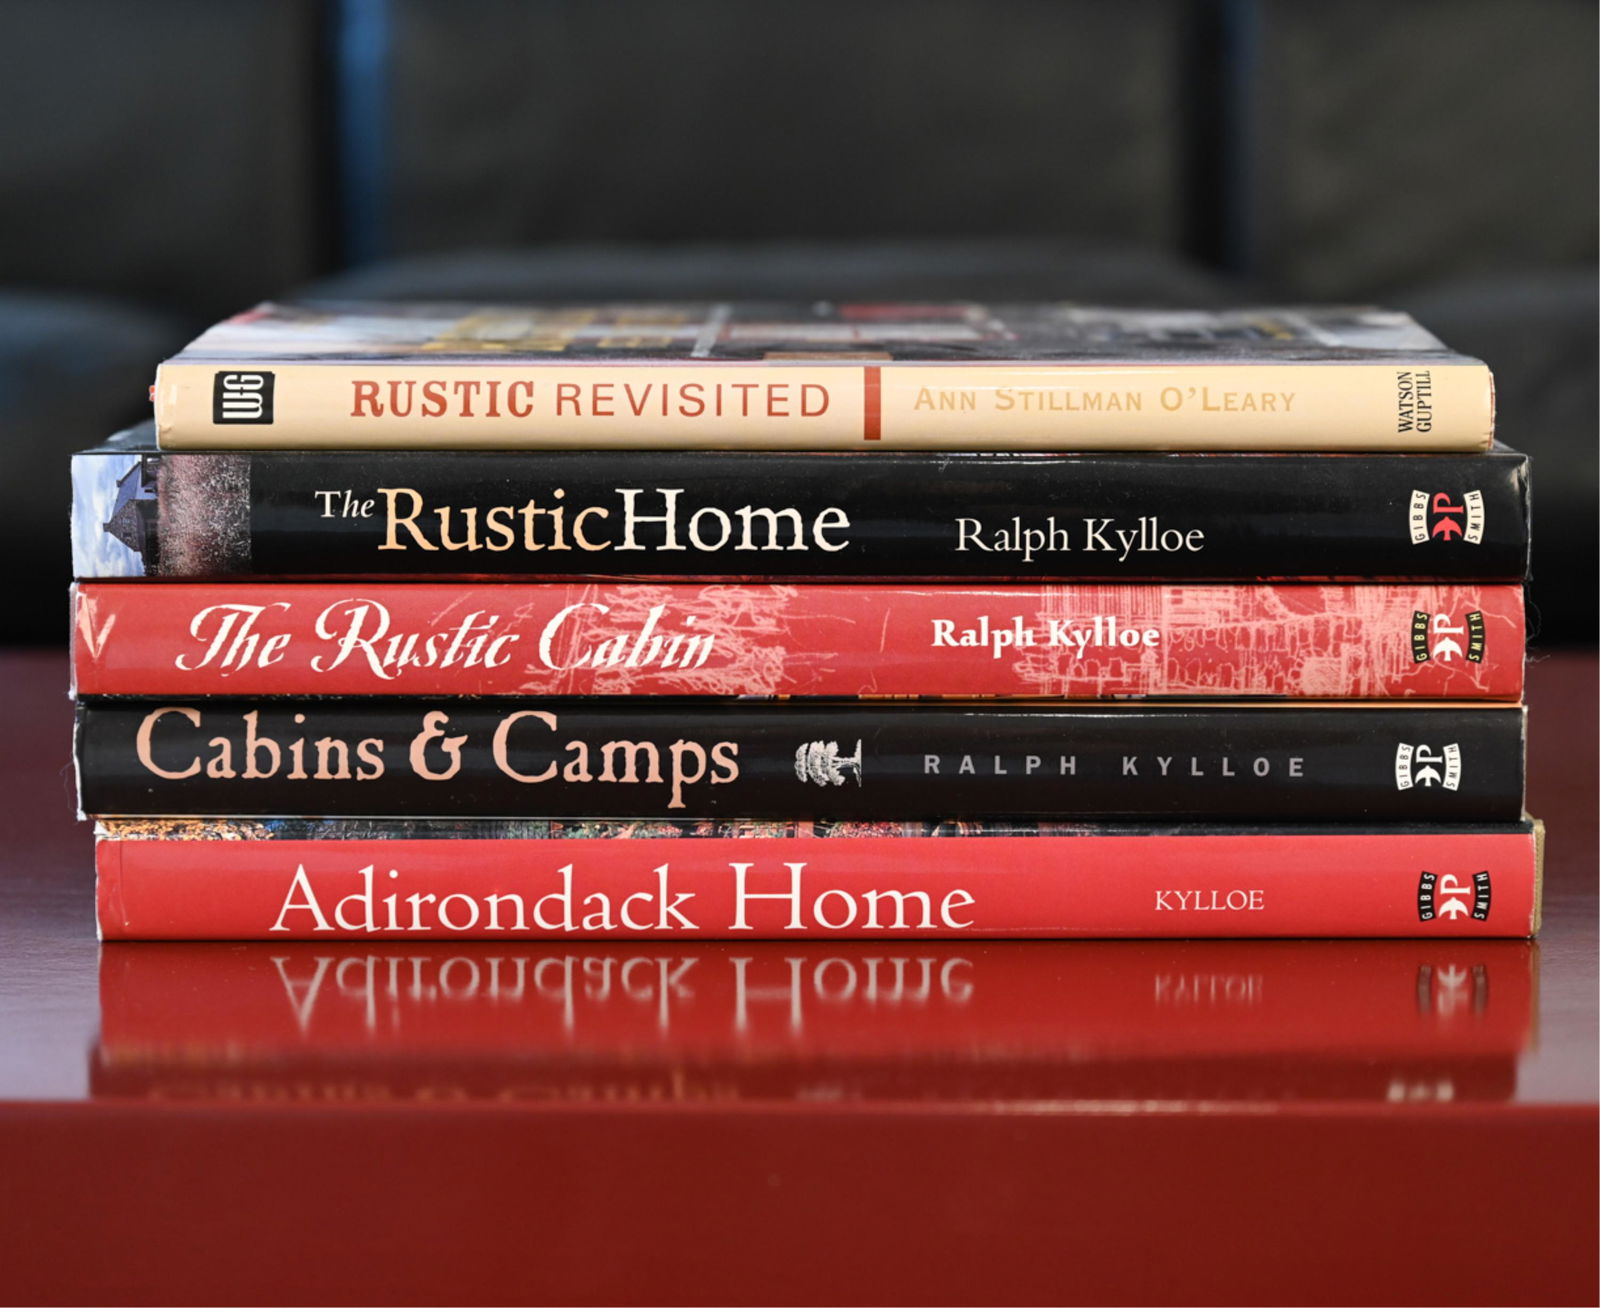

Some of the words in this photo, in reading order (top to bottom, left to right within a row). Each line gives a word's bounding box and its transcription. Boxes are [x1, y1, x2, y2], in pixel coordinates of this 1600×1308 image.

[350, 379, 535, 418] RUSTIC
[555, 382, 830, 417] REVISITED
[913, 386, 977, 412] ANN
[994, 386, 1143, 412] STILLMAN
[1159, 385, 1296, 412] O'LEARY
[1397, 371, 1414, 433] WATSON
[1415, 370, 1433, 433] GUPTILL
[314, 489, 375, 519] The
[1412, 492, 1427, 542] GIBBS
[1467, 492, 1482, 542] SMITH
[954, 516, 1072, 562] Ralph
[1082, 516, 1206, 562] Kylloe
[174, 601, 292, 678] The
[310, 597, 520, 681] Rustic
[538, 602, 717, 670] Cabin
[930, 615, 1038, 659] Ralph
[1047, 615, 1161, 659] Kylloe
[1413, 612, 1428, 662] GIBBS
[1468, 612, 1484, 662] SMITH
[135, 706, 386, 781] Cabins
[408, 709, 469, 782] &
[491, 709, 741, 809] Camps
[923, 754, 1078, 776] RALPH
[1121, 755, 1305, 778] KYLLOE
[1398, 745, 1412, 788] GIBBS
[1445, 745, 1459, 788] SMITH
[268, 862, 701, 933] Adirondack
[727, 861, 976, 932] Home
[1154, 889, 1266, 911] KYLLOE
[1419, 872, 1436, 920] GIBBS
[1473, 872, 1490, 920] SMITH
